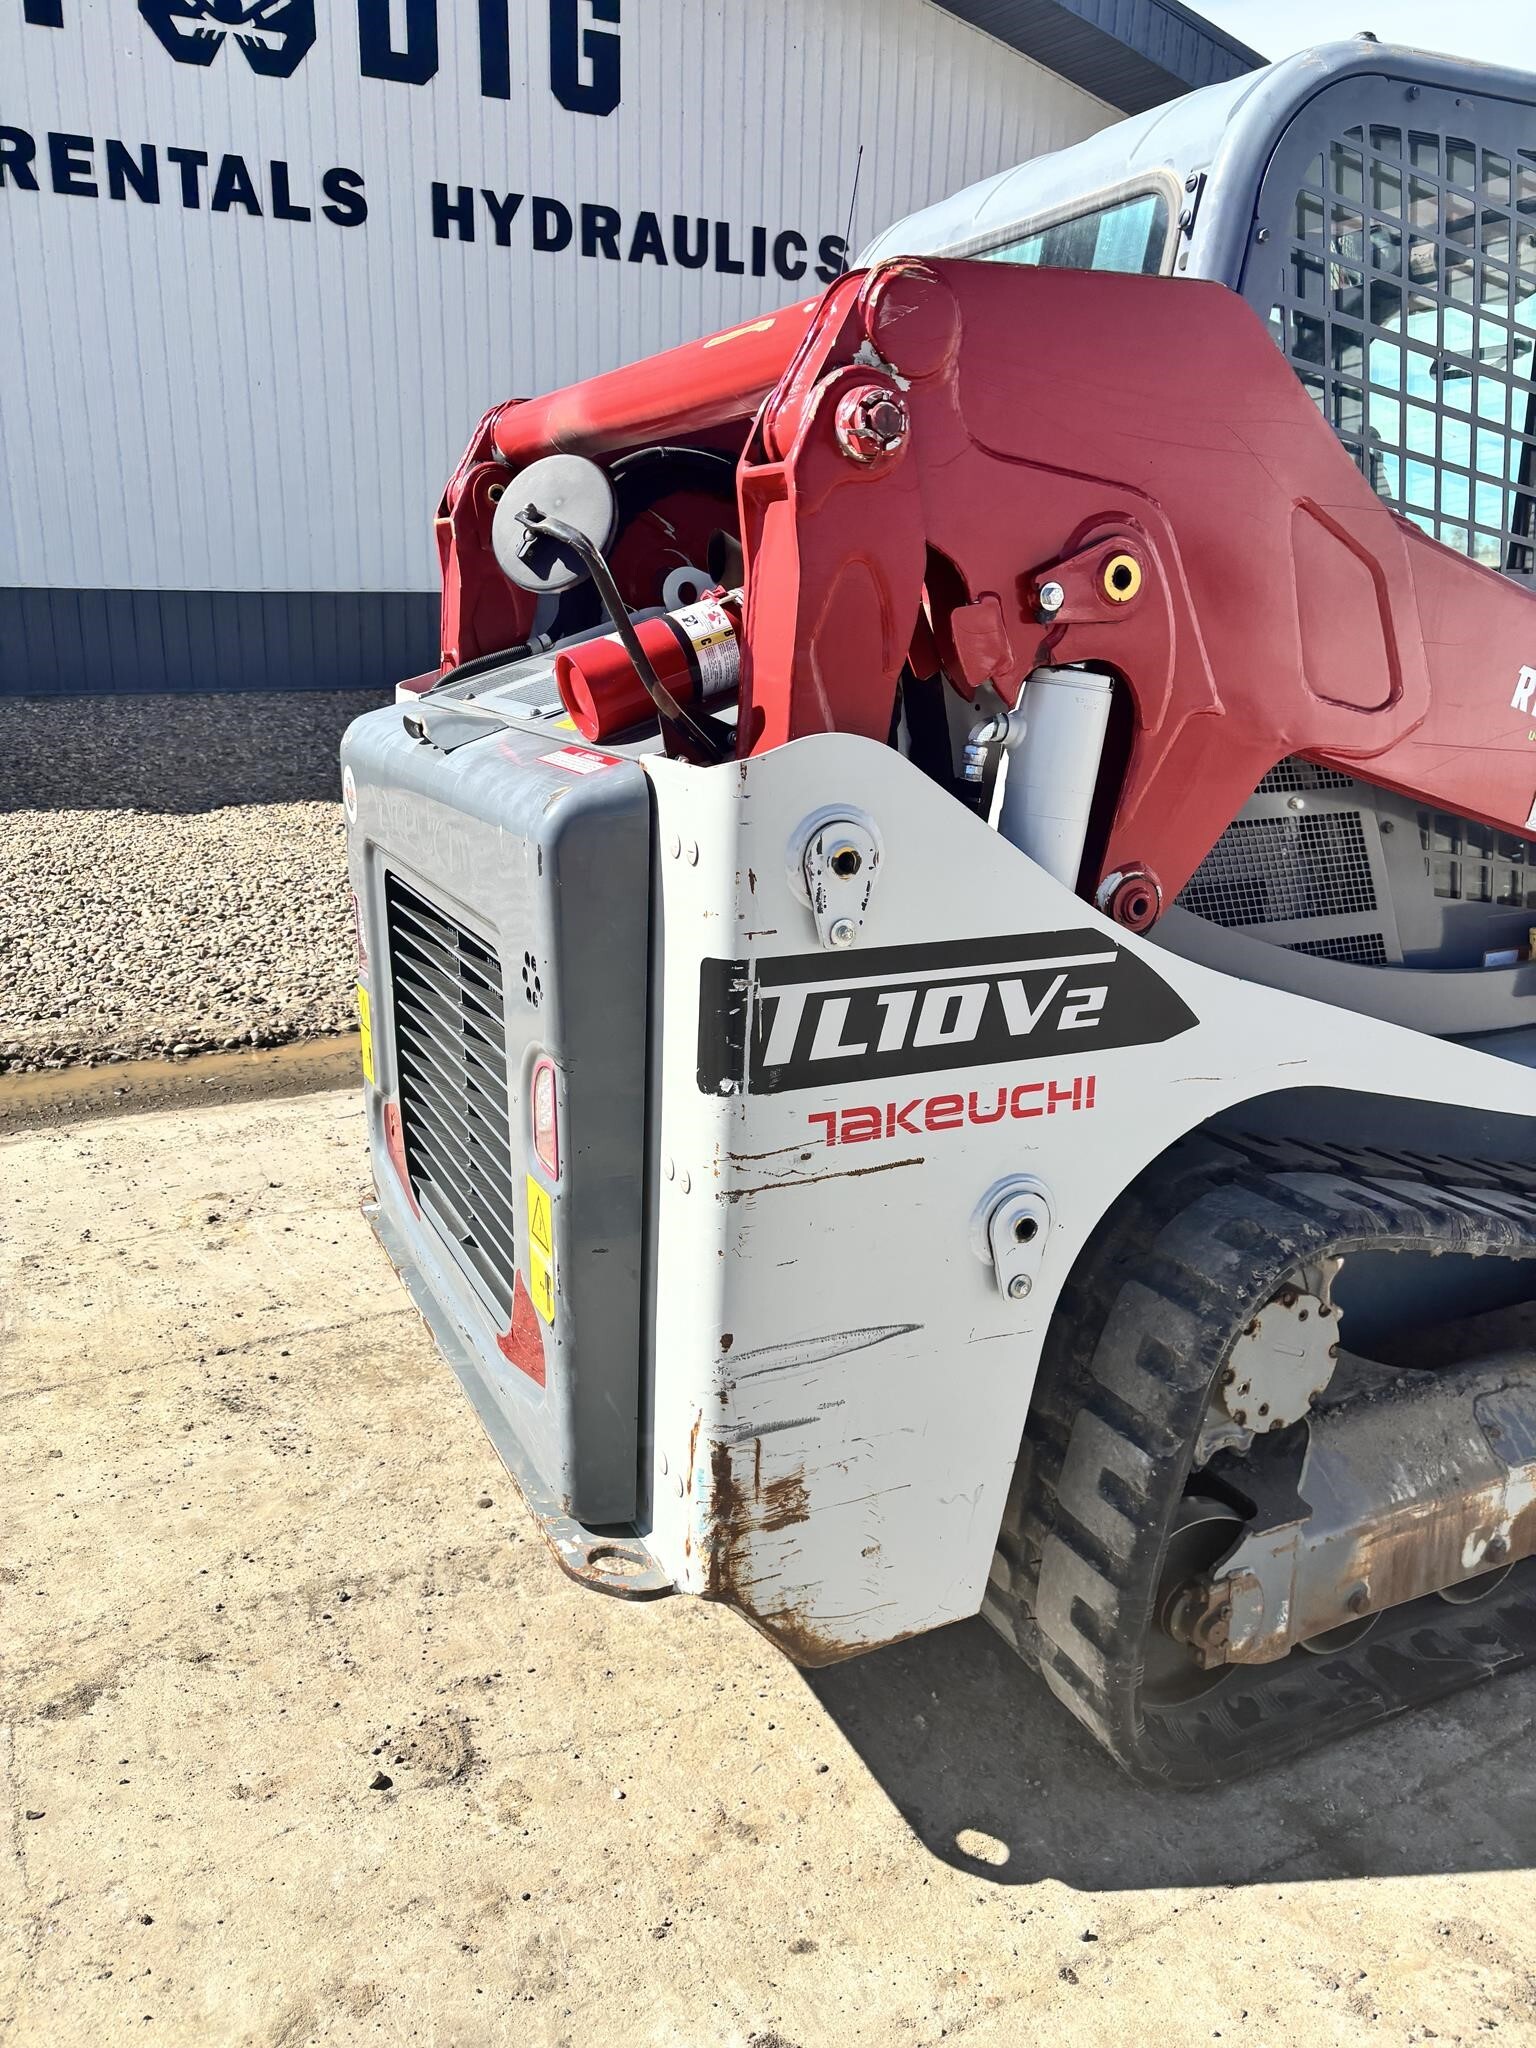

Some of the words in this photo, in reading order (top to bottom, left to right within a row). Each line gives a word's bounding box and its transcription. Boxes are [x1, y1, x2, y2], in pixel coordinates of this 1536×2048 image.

[0, 125, 368, 229] RENTALS
[431, 181, 850, 285] HYDRAULICS
[760, 951, 1118, 1067] TL10V2
